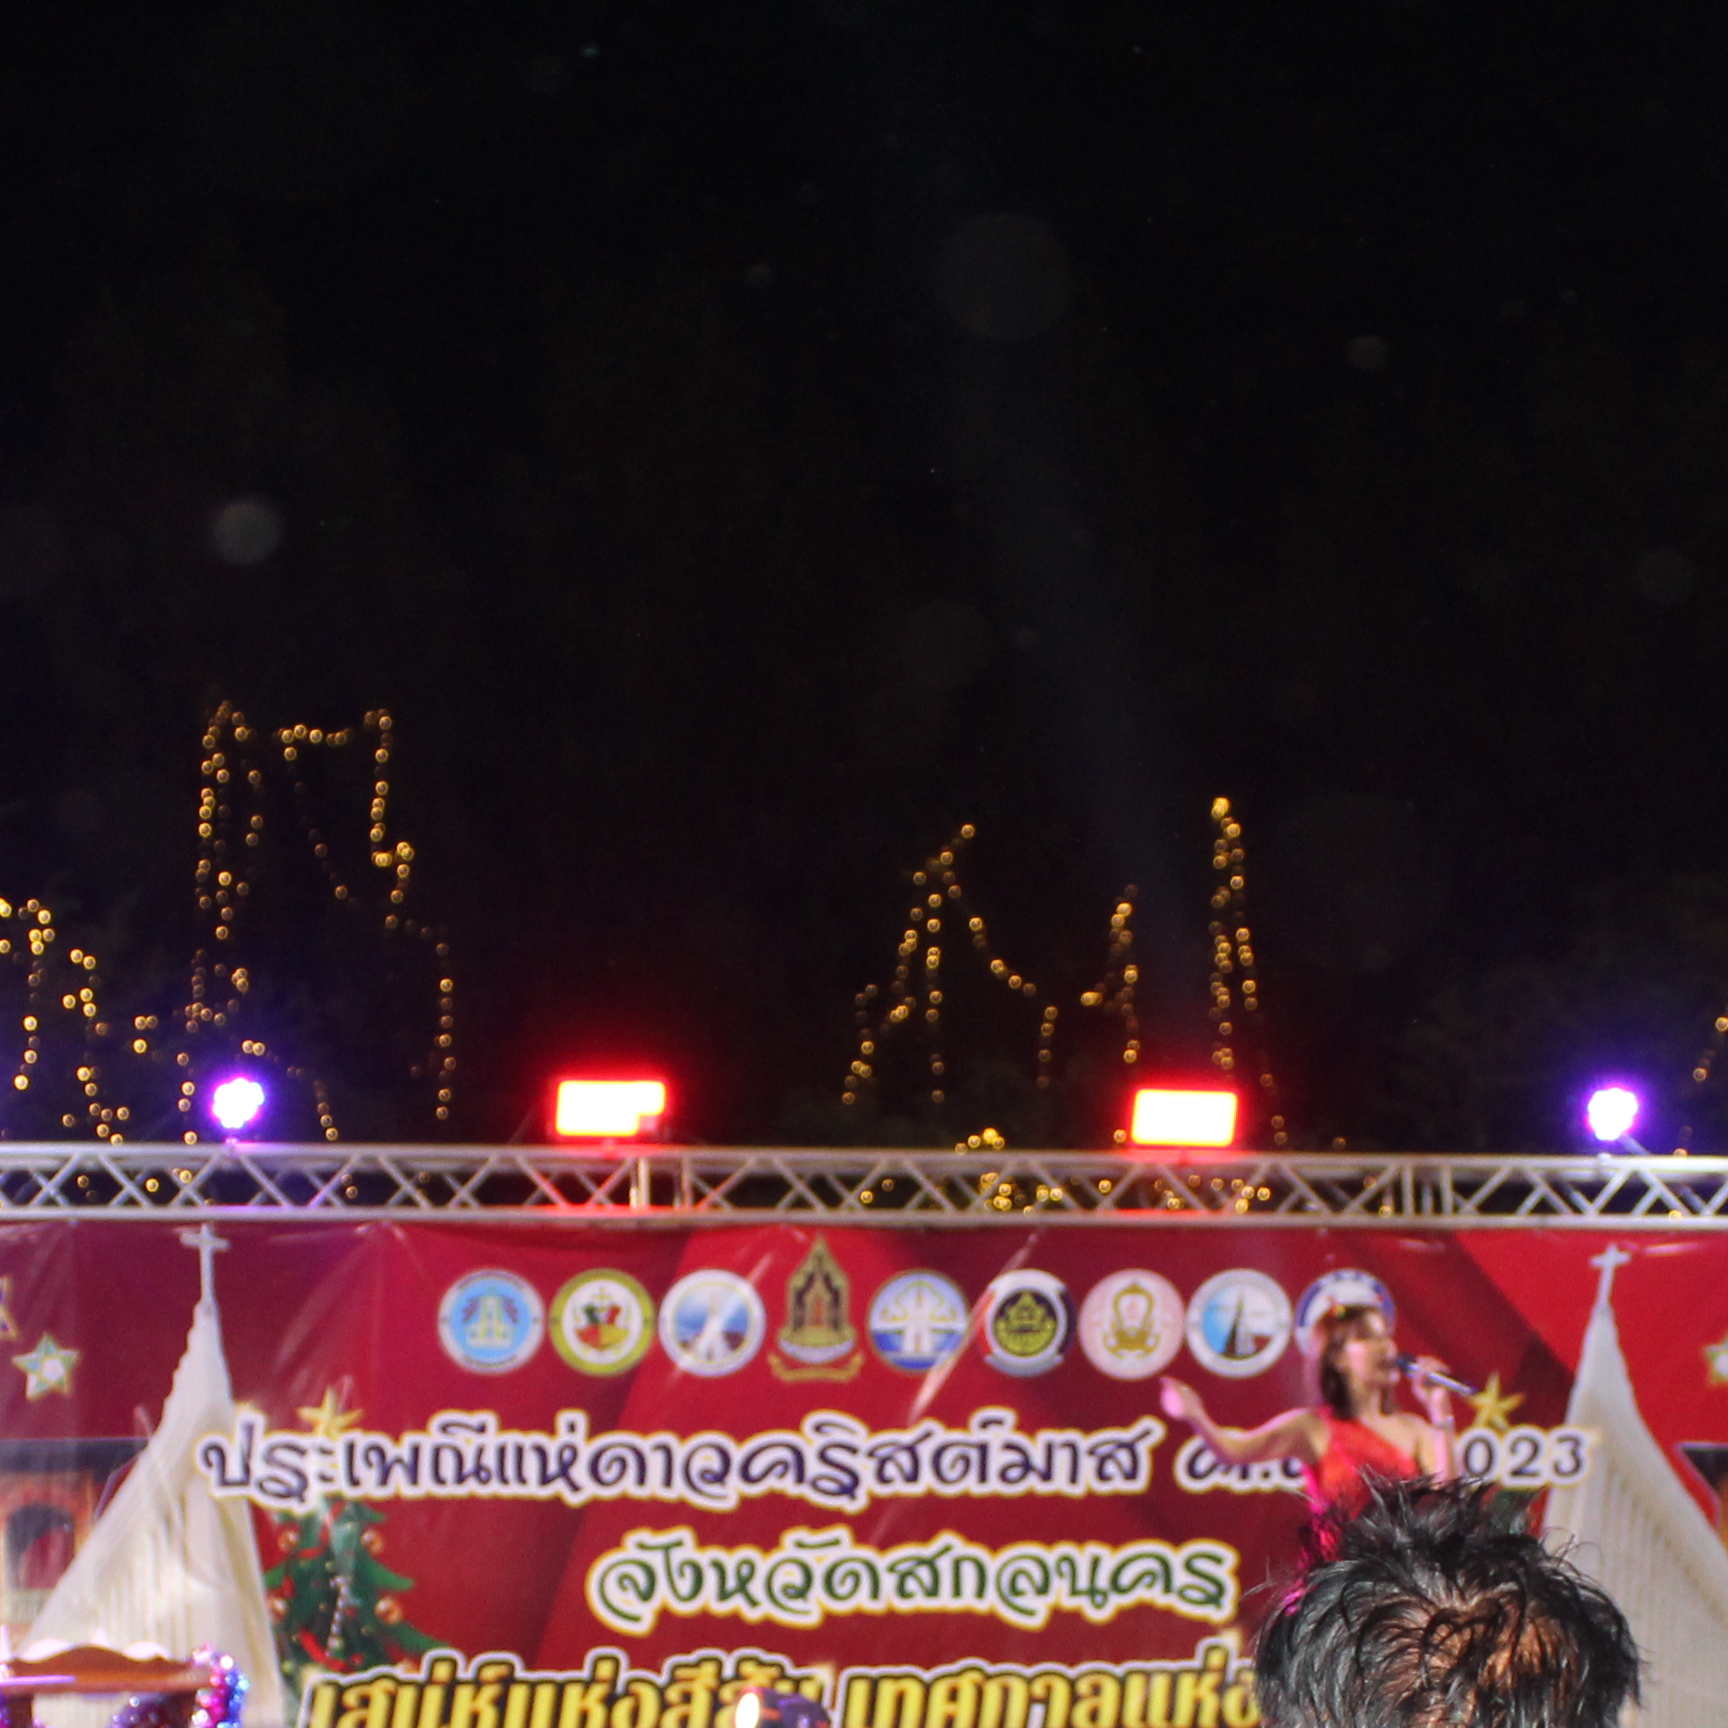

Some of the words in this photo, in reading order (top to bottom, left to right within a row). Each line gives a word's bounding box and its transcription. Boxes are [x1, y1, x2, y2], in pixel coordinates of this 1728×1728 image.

[198, 1414, 1156, 1506] ประเพณีแห่ดาวคริสต์มาส
[1460, 1430, 1588, 1482] 023
[594, 1534, 1228, 1622] จังหวัดสกลนคร
